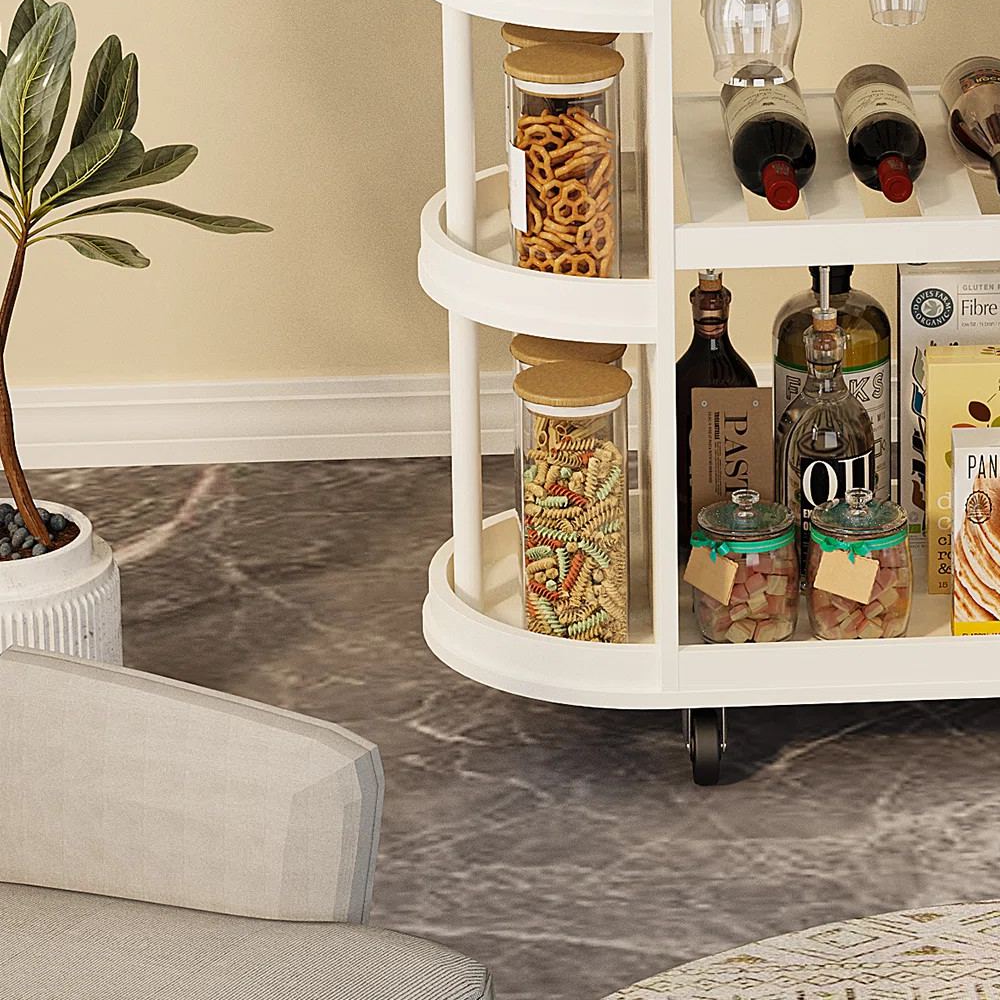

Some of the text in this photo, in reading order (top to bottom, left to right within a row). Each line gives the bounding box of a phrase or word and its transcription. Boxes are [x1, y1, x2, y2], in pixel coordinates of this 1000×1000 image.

[962, 283, 995, 291] GLUTEN
[961, 298, 998, 316] Fibre
[915, 311, 950, 326] ORGANIC
[723, 411, 749, 497] PAST
[938, 581, 948, 589] 15
